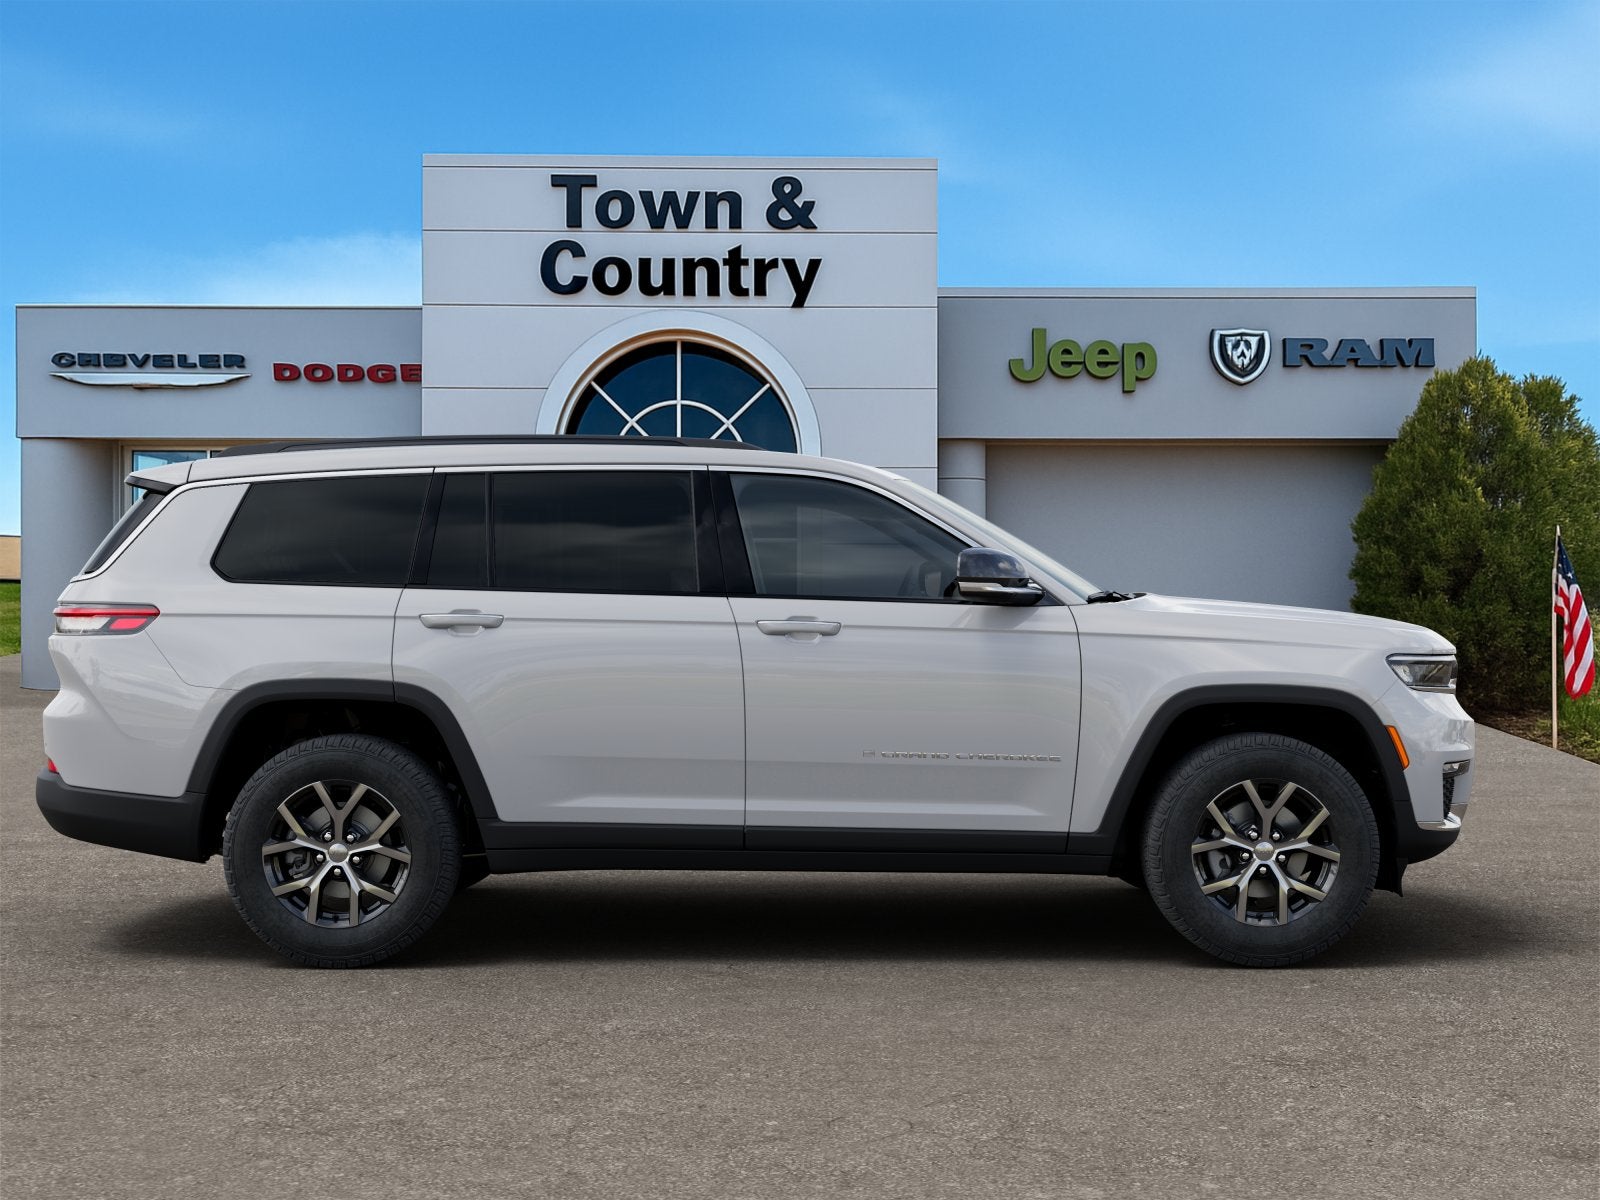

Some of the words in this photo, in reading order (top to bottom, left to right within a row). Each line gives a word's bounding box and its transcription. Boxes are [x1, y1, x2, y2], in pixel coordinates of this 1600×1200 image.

[550, 174, 743, 229] Town
[765, 176, 818, 229] &
[540, 239, 823, 308] Country
[273, 363, 422, 382] DODGE
[1009, 328, 1157, 393] Jeep
[1282, 338, 1436, 368] RAM
